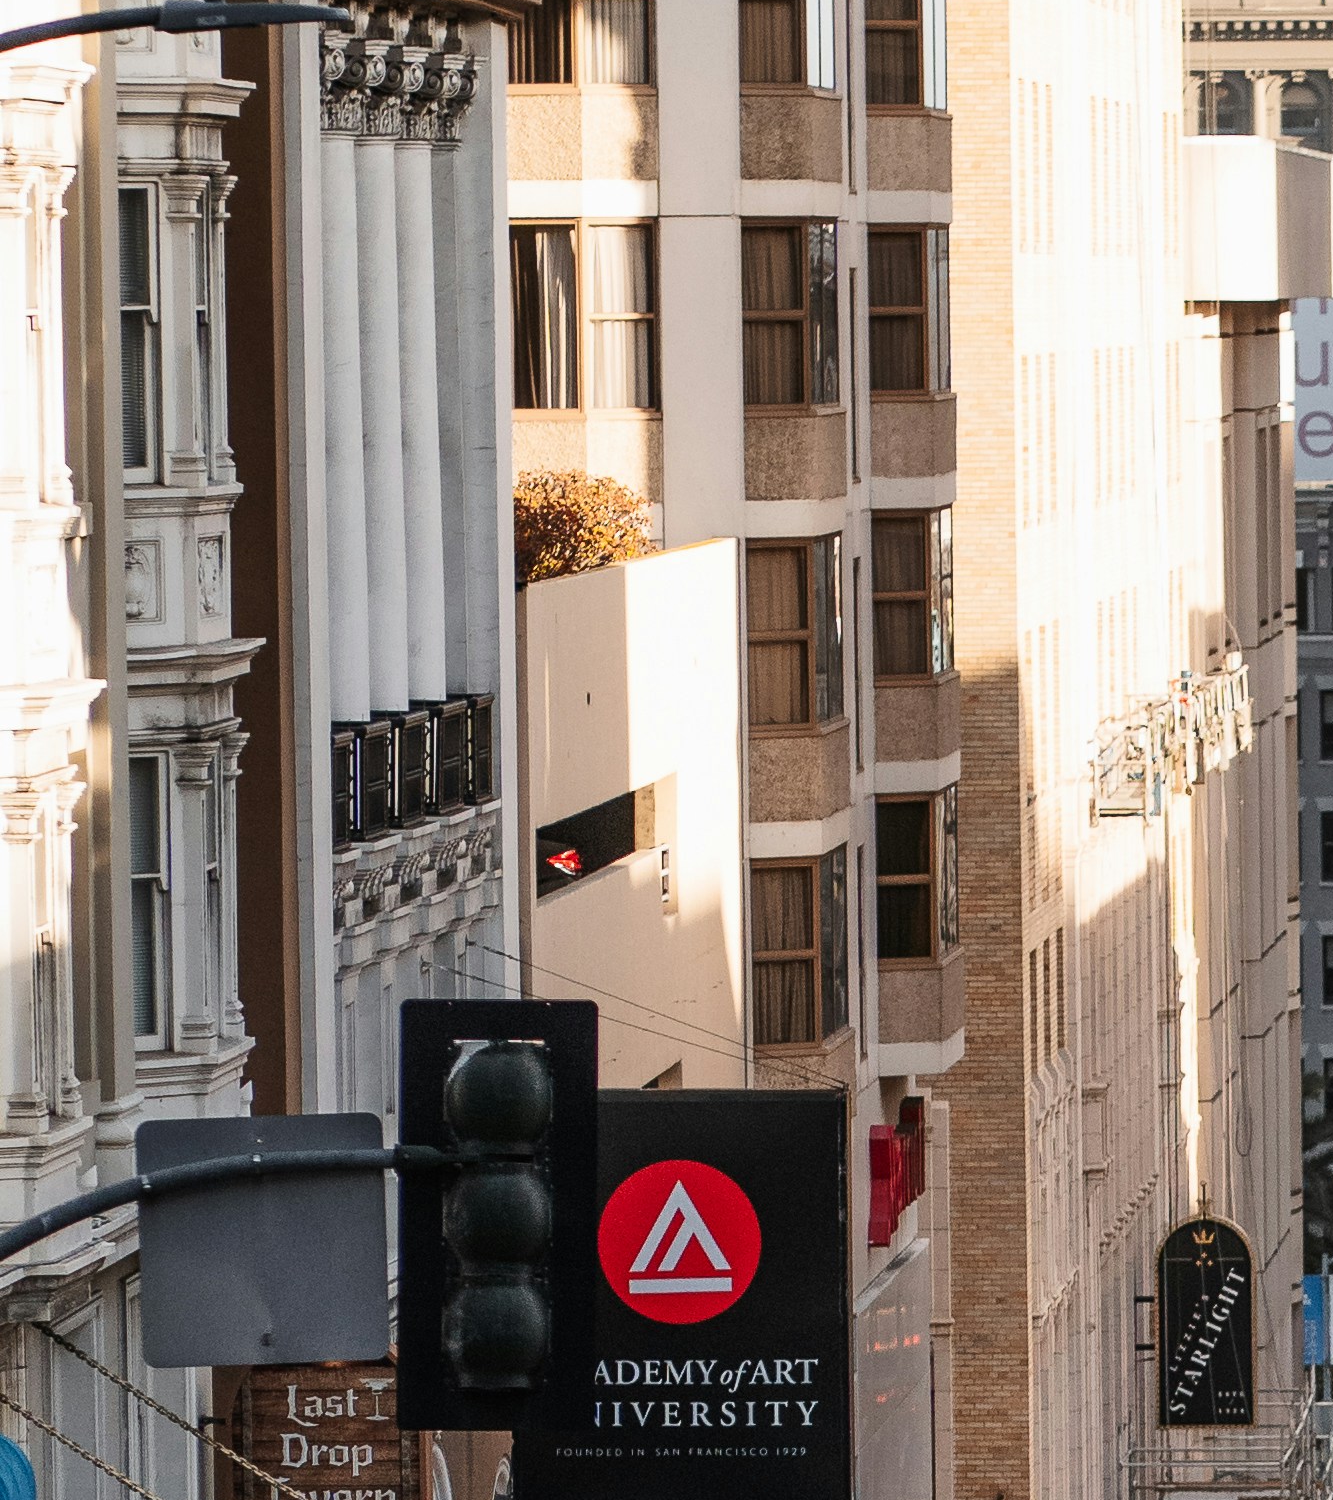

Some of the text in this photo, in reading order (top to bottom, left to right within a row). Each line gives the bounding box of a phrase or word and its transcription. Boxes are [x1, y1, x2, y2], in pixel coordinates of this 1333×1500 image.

[1169, 1267, 1245, 1415] STARLIGHT
[594, 1359, 819, 1393] ADEMY of ART
[286, 1384, 359, 1427] Last
[594, 1401, 819, 1427] IVERSITY
[280, 1433, 373, 1477] Drop
[556, 1447, 807, 1457] FOUNDED IN SAN FRANCISCO 1929
